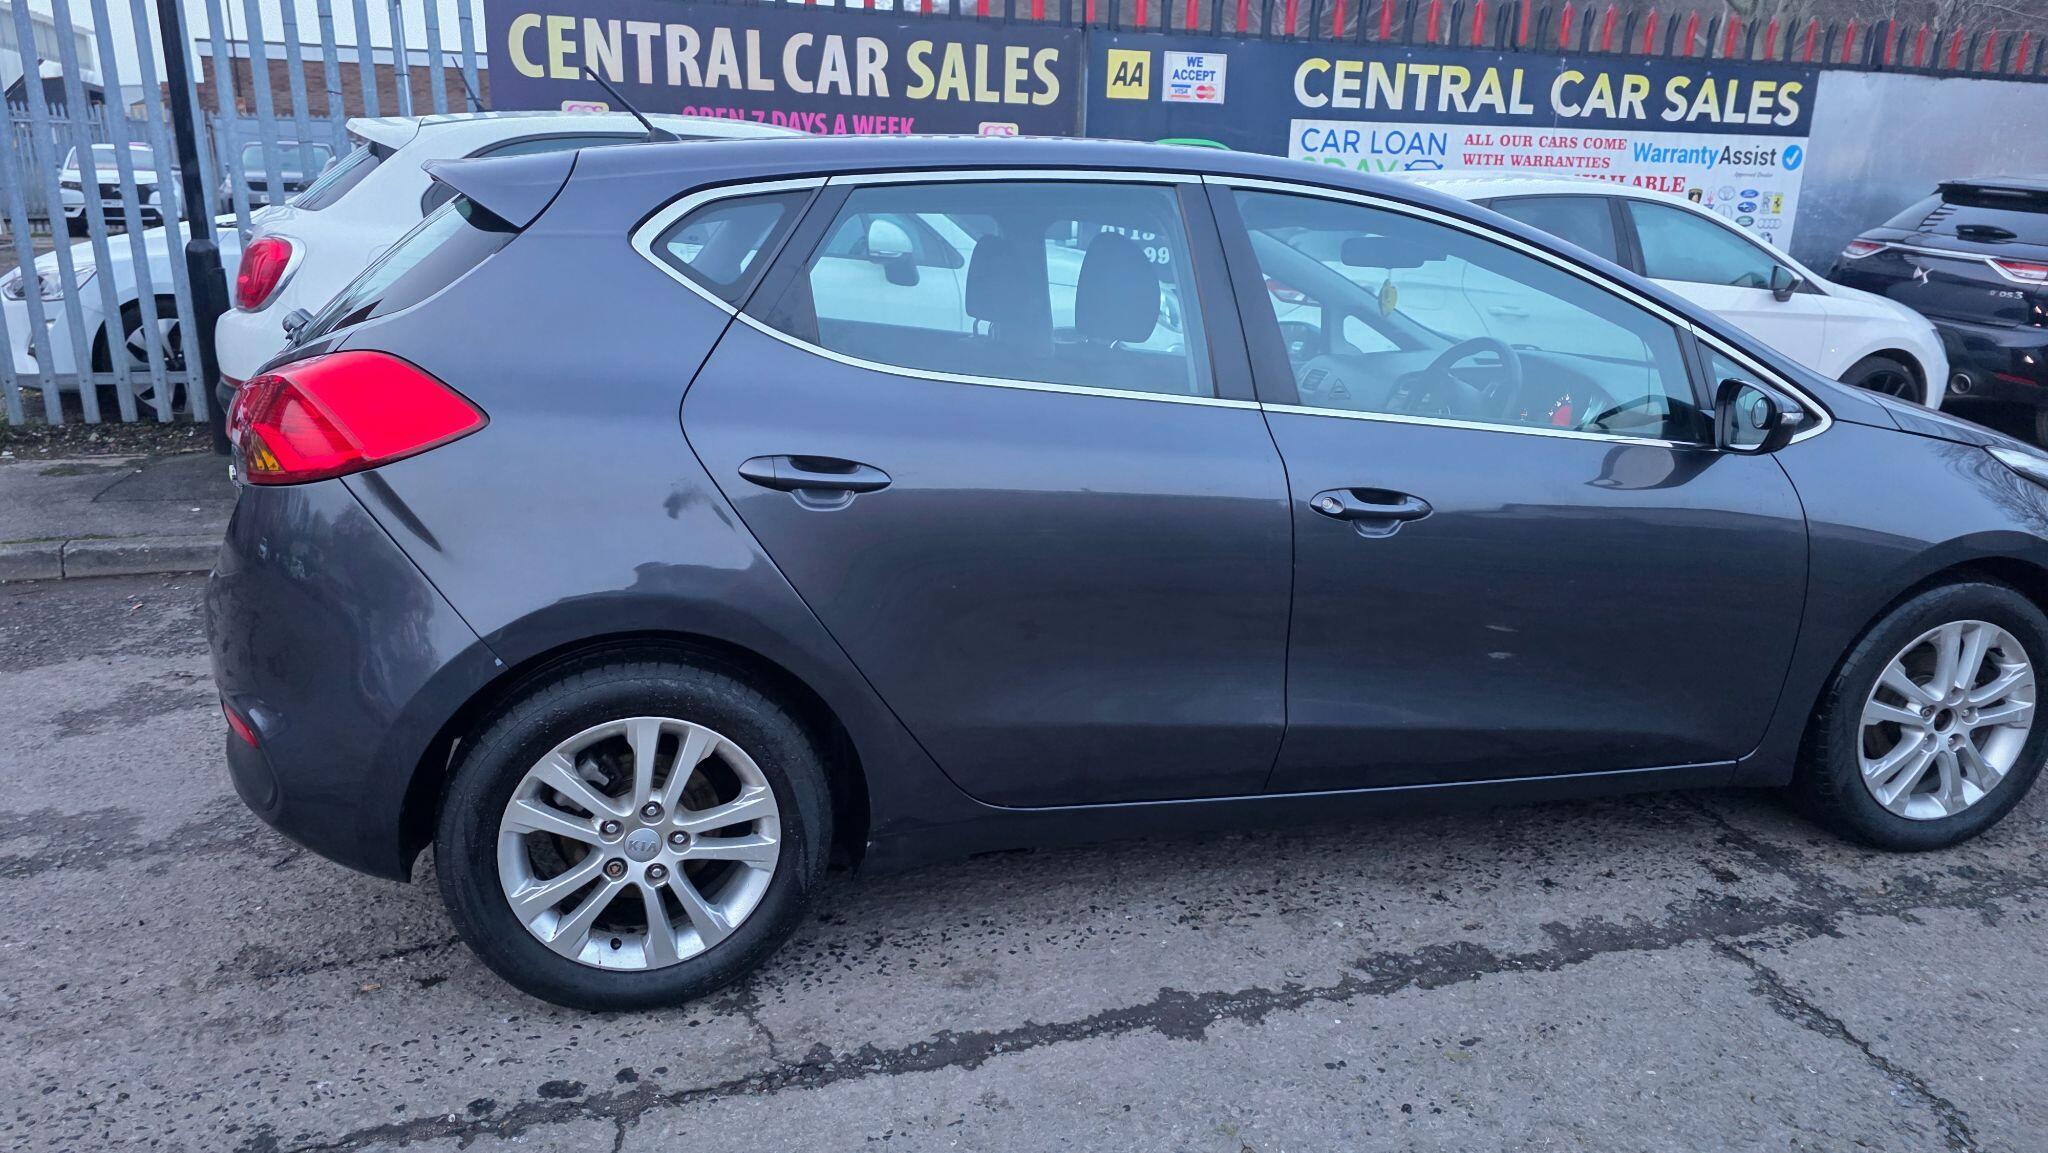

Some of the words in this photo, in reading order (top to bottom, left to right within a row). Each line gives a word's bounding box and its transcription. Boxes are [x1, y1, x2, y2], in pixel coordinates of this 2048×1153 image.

[508, 13, 775, 91] CENTRAL
[782, 32, 890, 98] CAR
[906, 40, 1060, 106] SALES
[1186, 56, 1204, 68] WE
[1112, 60, 1144, 87] AA
[1172, 69, 1216, 82] ACCEPT
[1293, 57, 1534, 115] CENTRAL
[1550, 70, 1650, 119] CAR
[1660, 75, 1803, 126] SALES
[772, 110, 828, 136] DAYS
[833, 113, 847, 136] A
[852, 114, 915, 136] WEEK
[1301, 127, 1361, 153] CAR
[1370, 130, 1448, 156] LOAN
[1464, 133, 1494, 146] ALL
[1499, 134, 1533, 147] OUR
[1538, 135, 1578, 149] CARS
[1582, 137, 1627, 150] COME
[1463, 153, 1505, 166] WITH
[1510, 154, 1611, 169] WARRANTIES
[1633, 141, 1777, 170] WarrantyAssist
